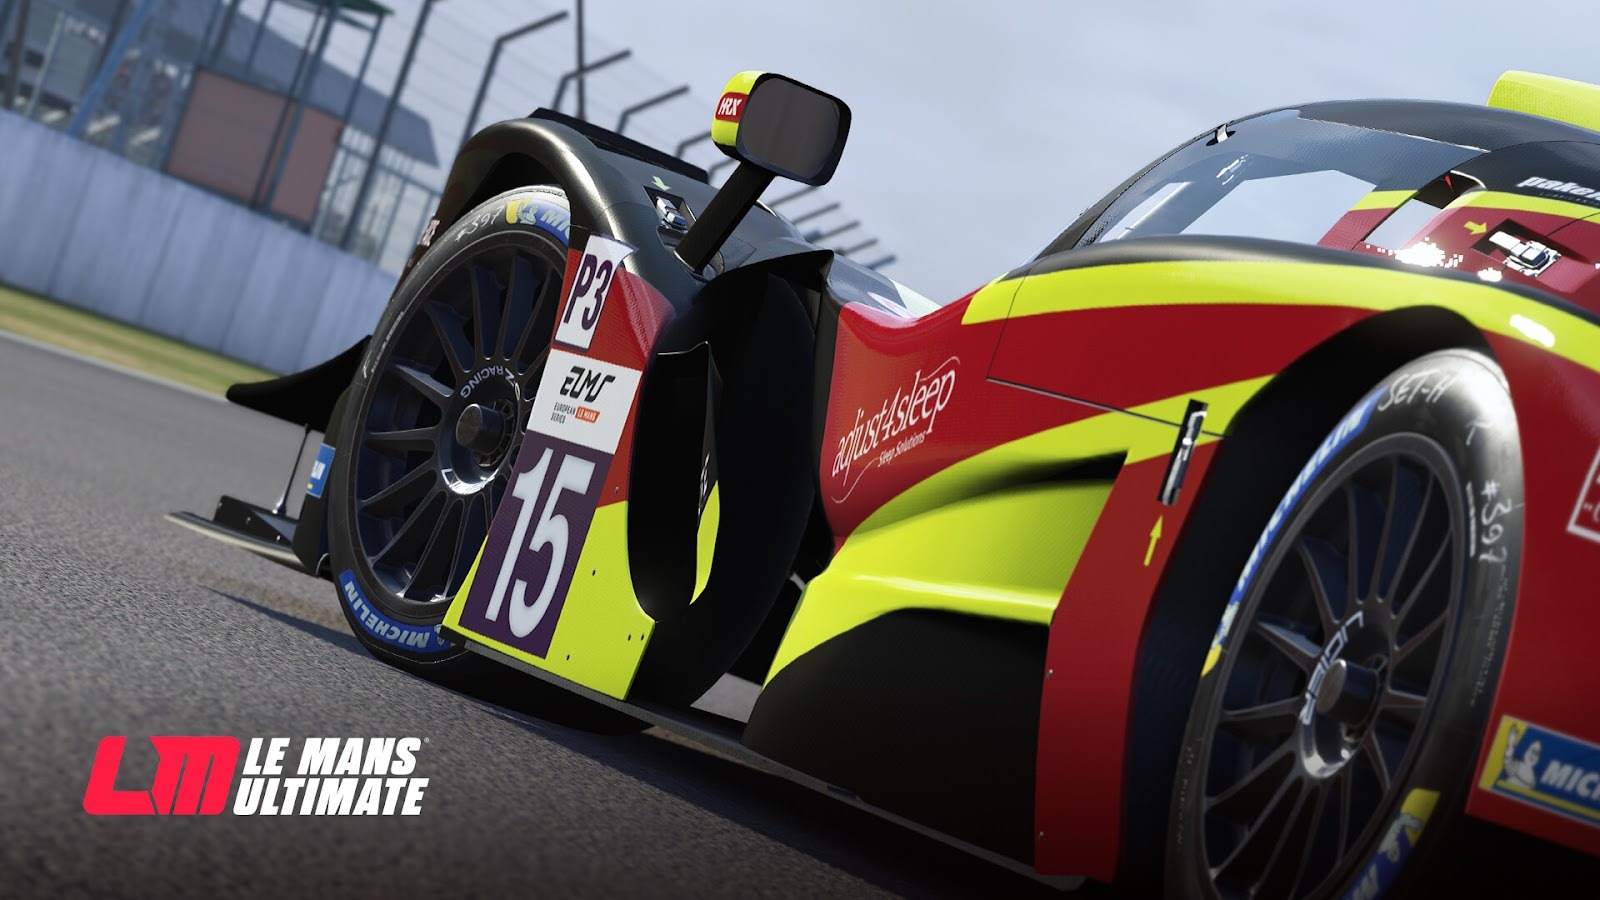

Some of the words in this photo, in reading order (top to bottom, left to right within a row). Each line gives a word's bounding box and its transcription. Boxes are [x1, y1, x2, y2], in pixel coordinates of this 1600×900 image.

[717, 97, 743, 116] HRX
[563, 253, 613, 331] P3
[460, 365, 504, 398] RACING
[554, 402, 577, 416] EUROPEAN
[831, 369, 956, 487] adjust4sleep
[878, 448, 895, 467] Sleep
[894, 431, 926, 458] Solutions
[485, 447, 596, 639] 15
[344, 580, 431, 649] MICHELIN
